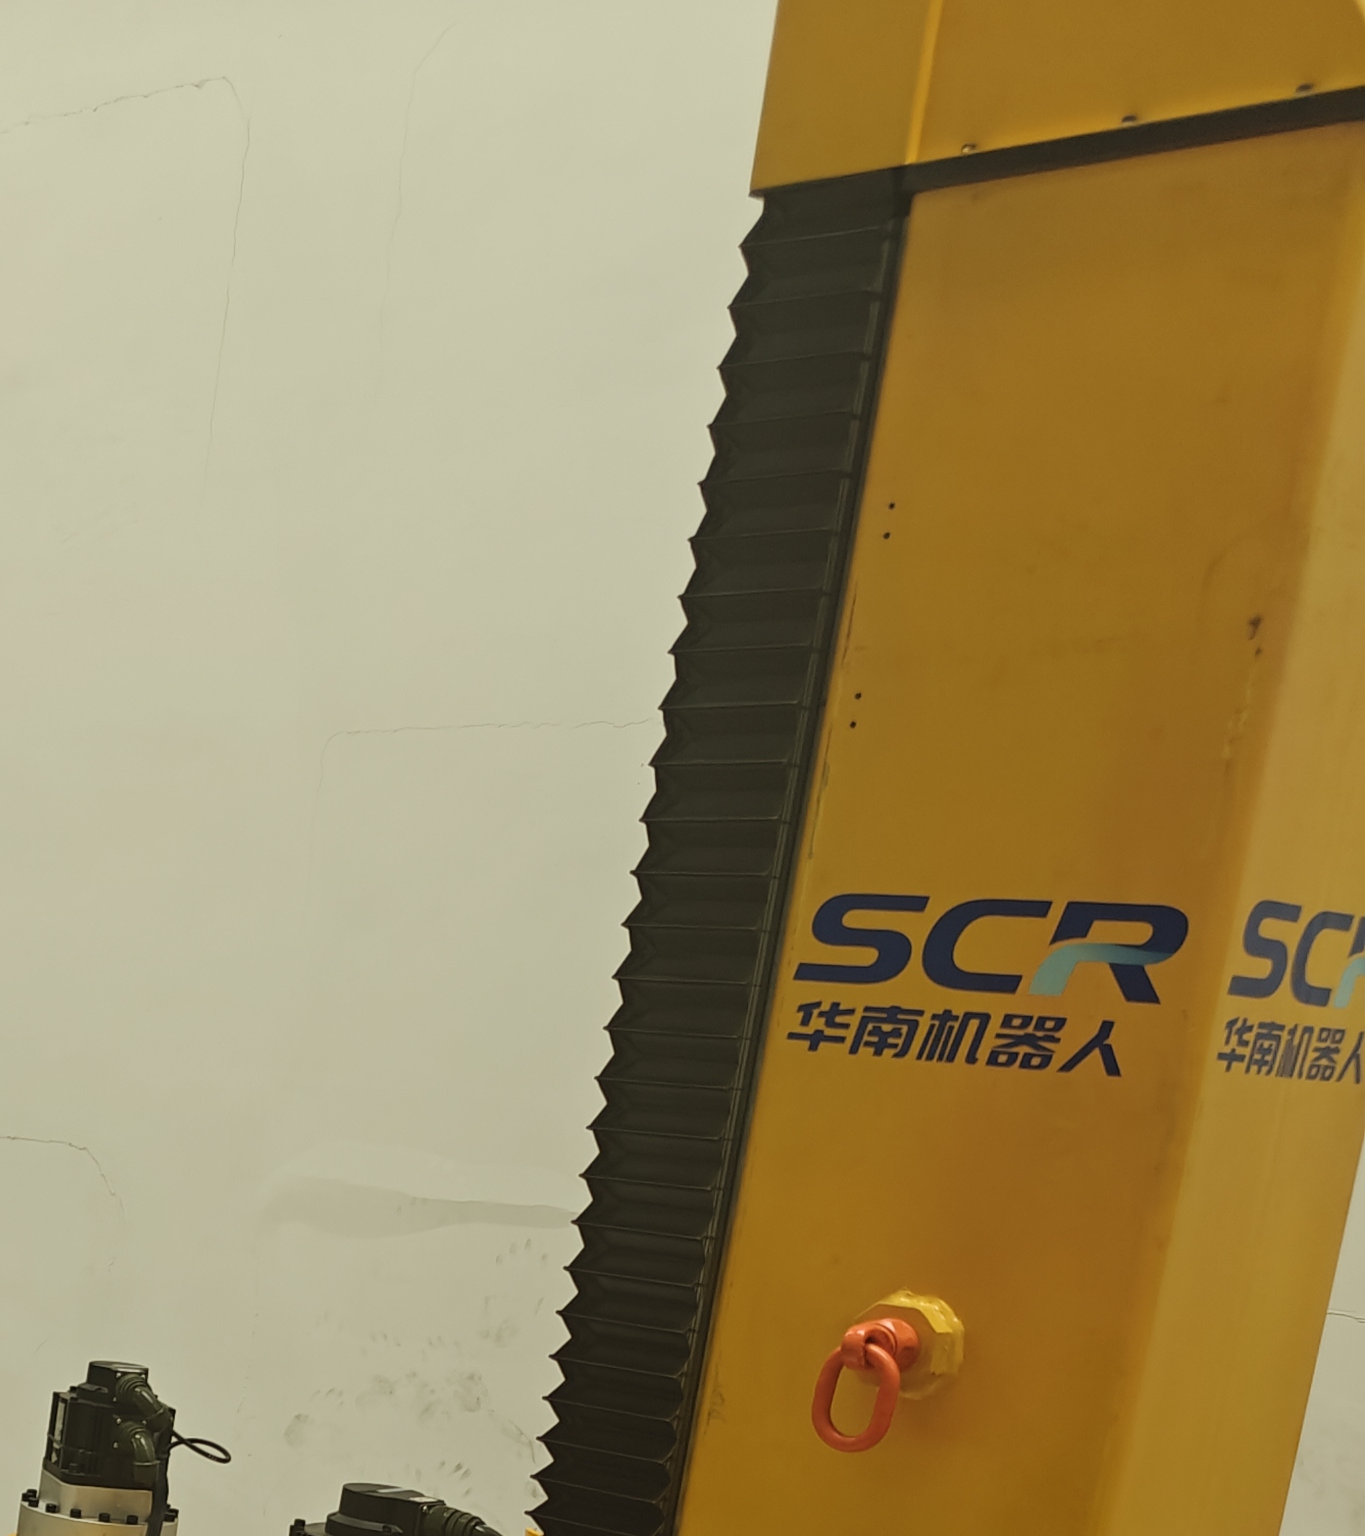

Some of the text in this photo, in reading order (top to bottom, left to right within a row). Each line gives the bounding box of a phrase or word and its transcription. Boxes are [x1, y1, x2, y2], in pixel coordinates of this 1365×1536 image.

[792, 893, 1189, 1005] SCR
[786, 999, 1123, 1077] 华南机器人
